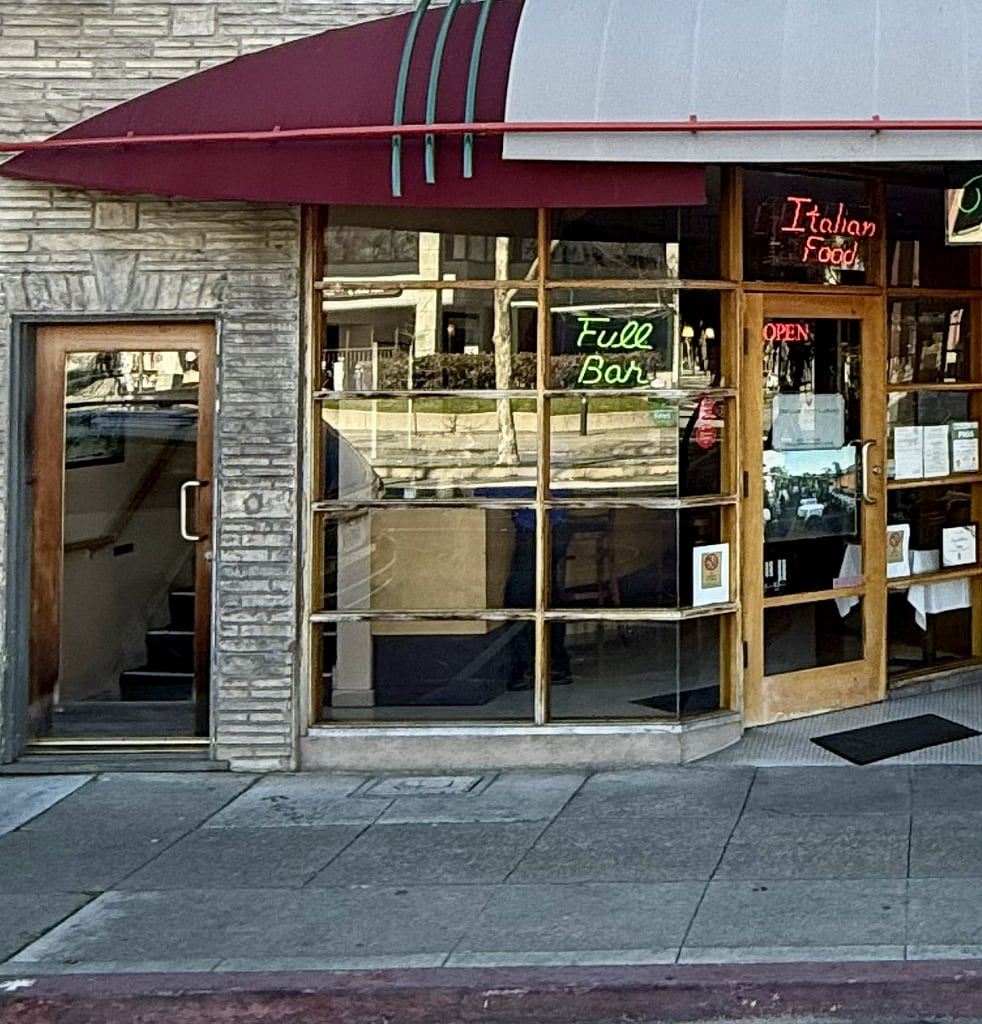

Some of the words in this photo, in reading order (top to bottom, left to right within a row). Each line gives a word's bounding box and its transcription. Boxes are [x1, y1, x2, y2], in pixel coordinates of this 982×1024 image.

[781, 196, 876, 237] Italian
[802, 235, 858, 265] Food
[577, 317, 653, 350] Full
[762, 322, 810, 342] OPEN
[577, 354, 650, 385] Bar
